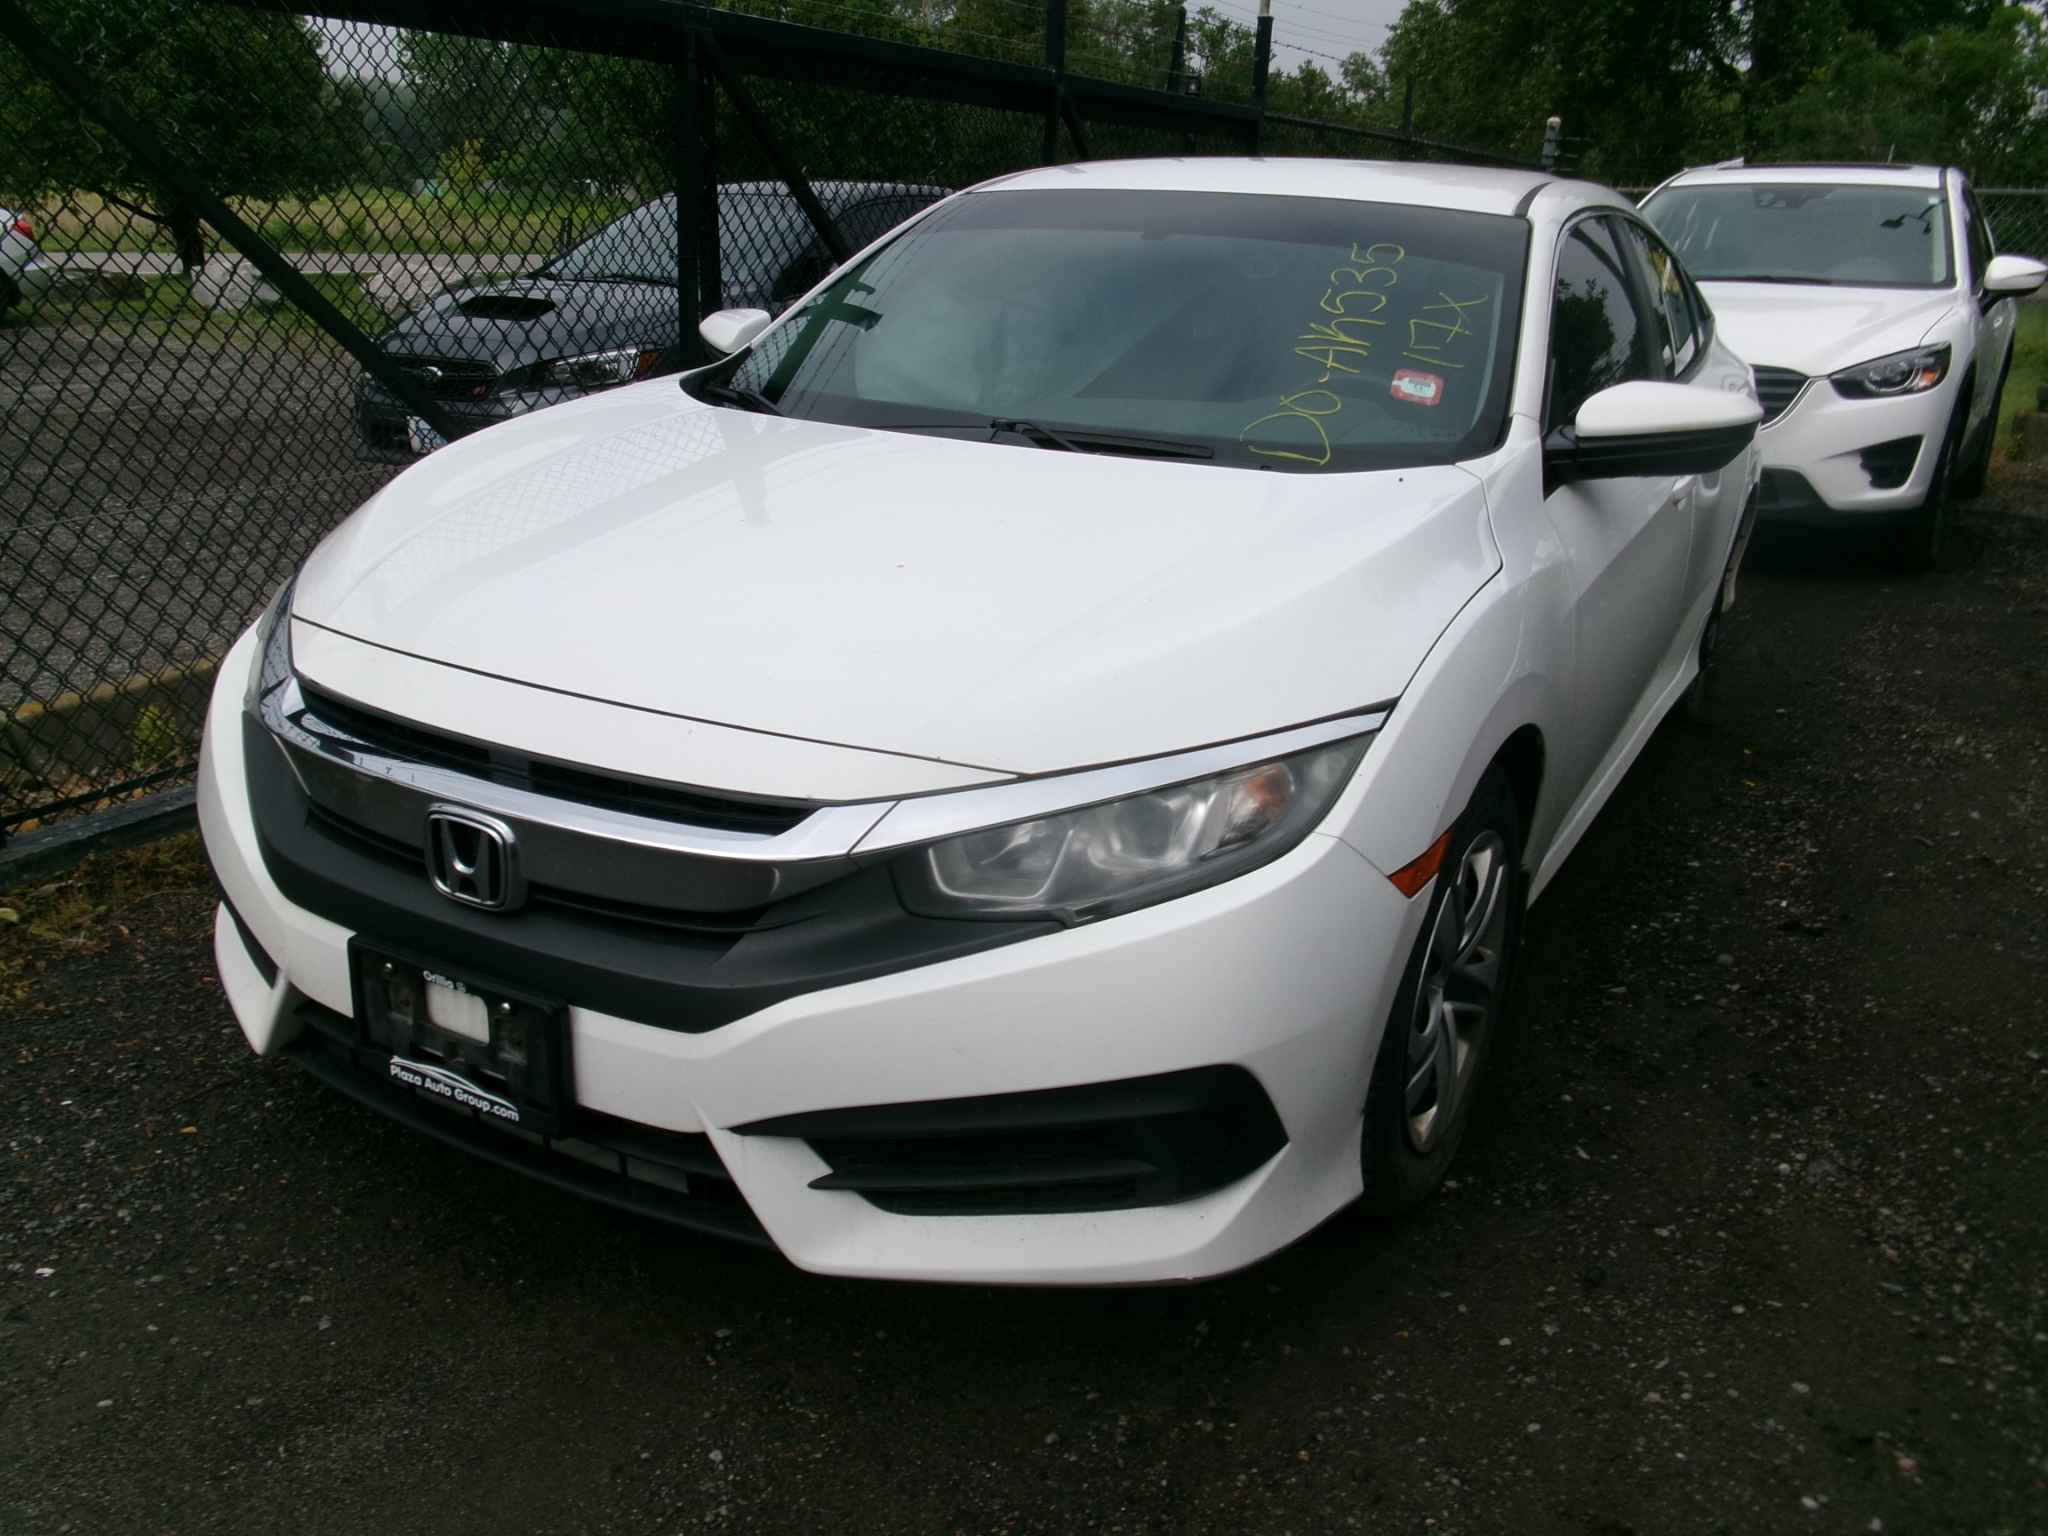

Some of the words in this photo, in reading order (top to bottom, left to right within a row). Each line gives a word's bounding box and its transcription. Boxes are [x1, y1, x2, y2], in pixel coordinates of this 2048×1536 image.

[390, 1065, 422, 1086] Plaza
[424, 1078, 452, 1096] Auto
[454, 1088, 519, 1121] Group.com
